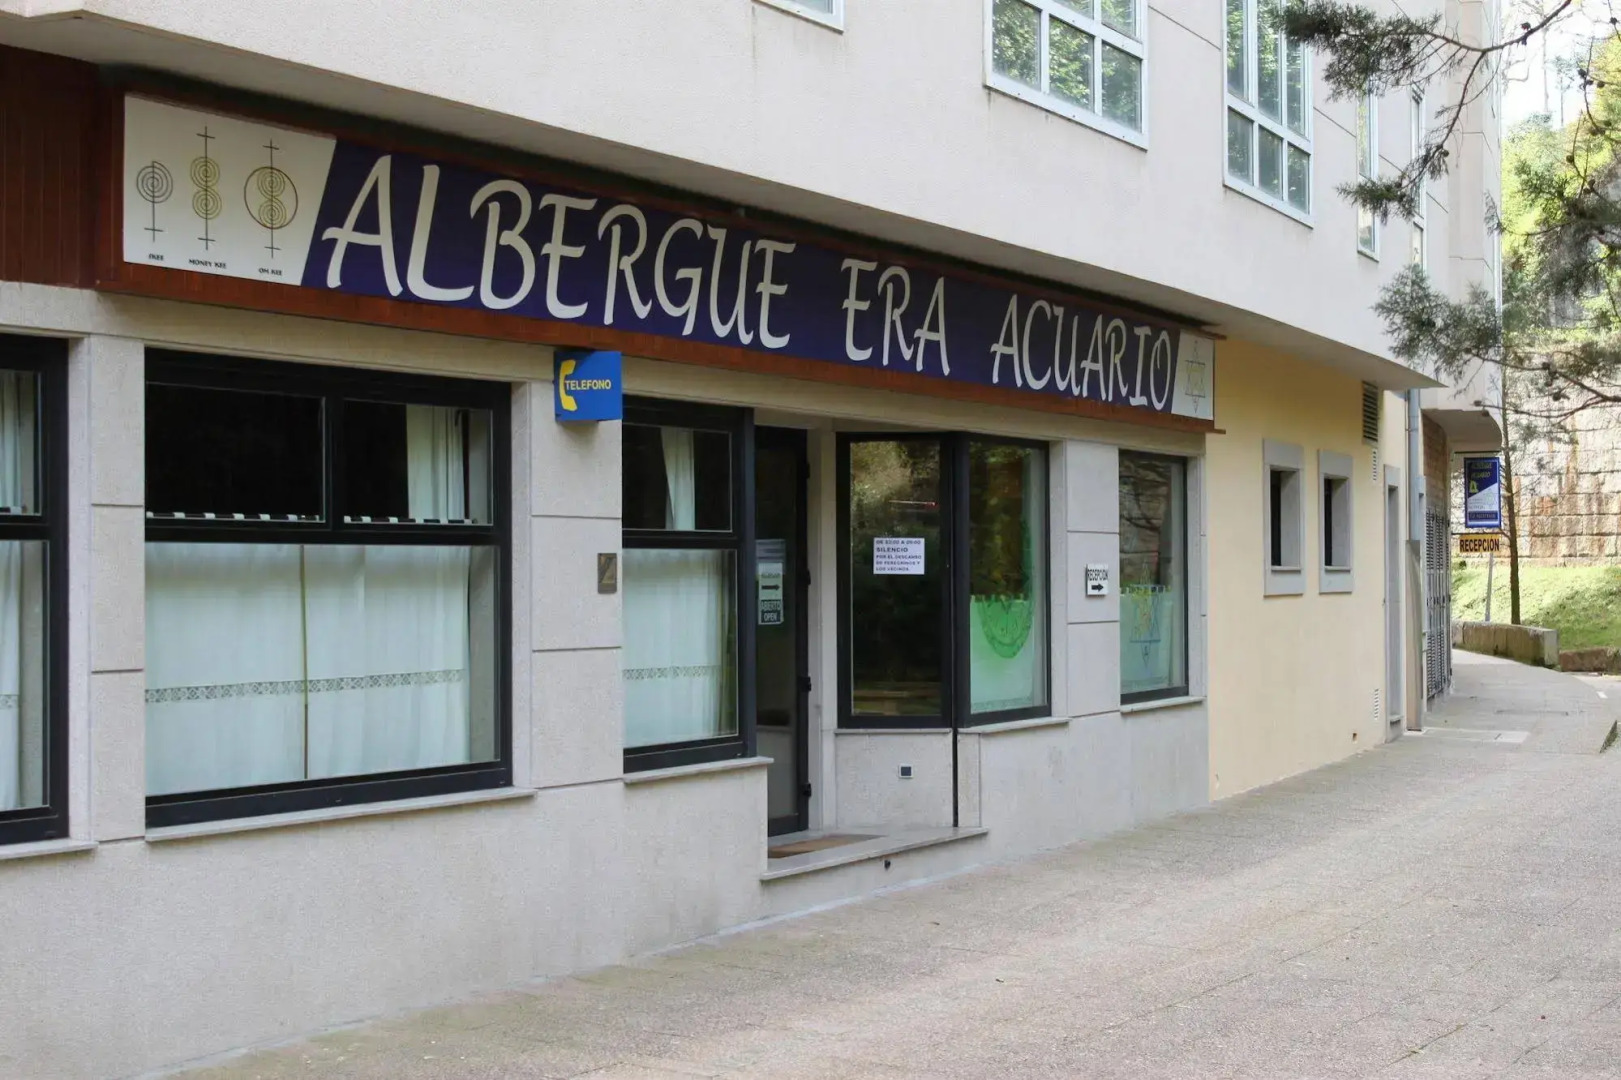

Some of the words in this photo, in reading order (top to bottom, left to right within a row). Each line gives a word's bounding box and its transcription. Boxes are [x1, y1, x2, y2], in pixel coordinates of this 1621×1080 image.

[321, 154, 797, 349] ALBERGUE
[841, 258, 951, 377] ERA
[989, 294, 1172, 411] ACUARIO
[565, 379, 612, 390] TELEFONO
[763, 612, 778, 621] OPEN
